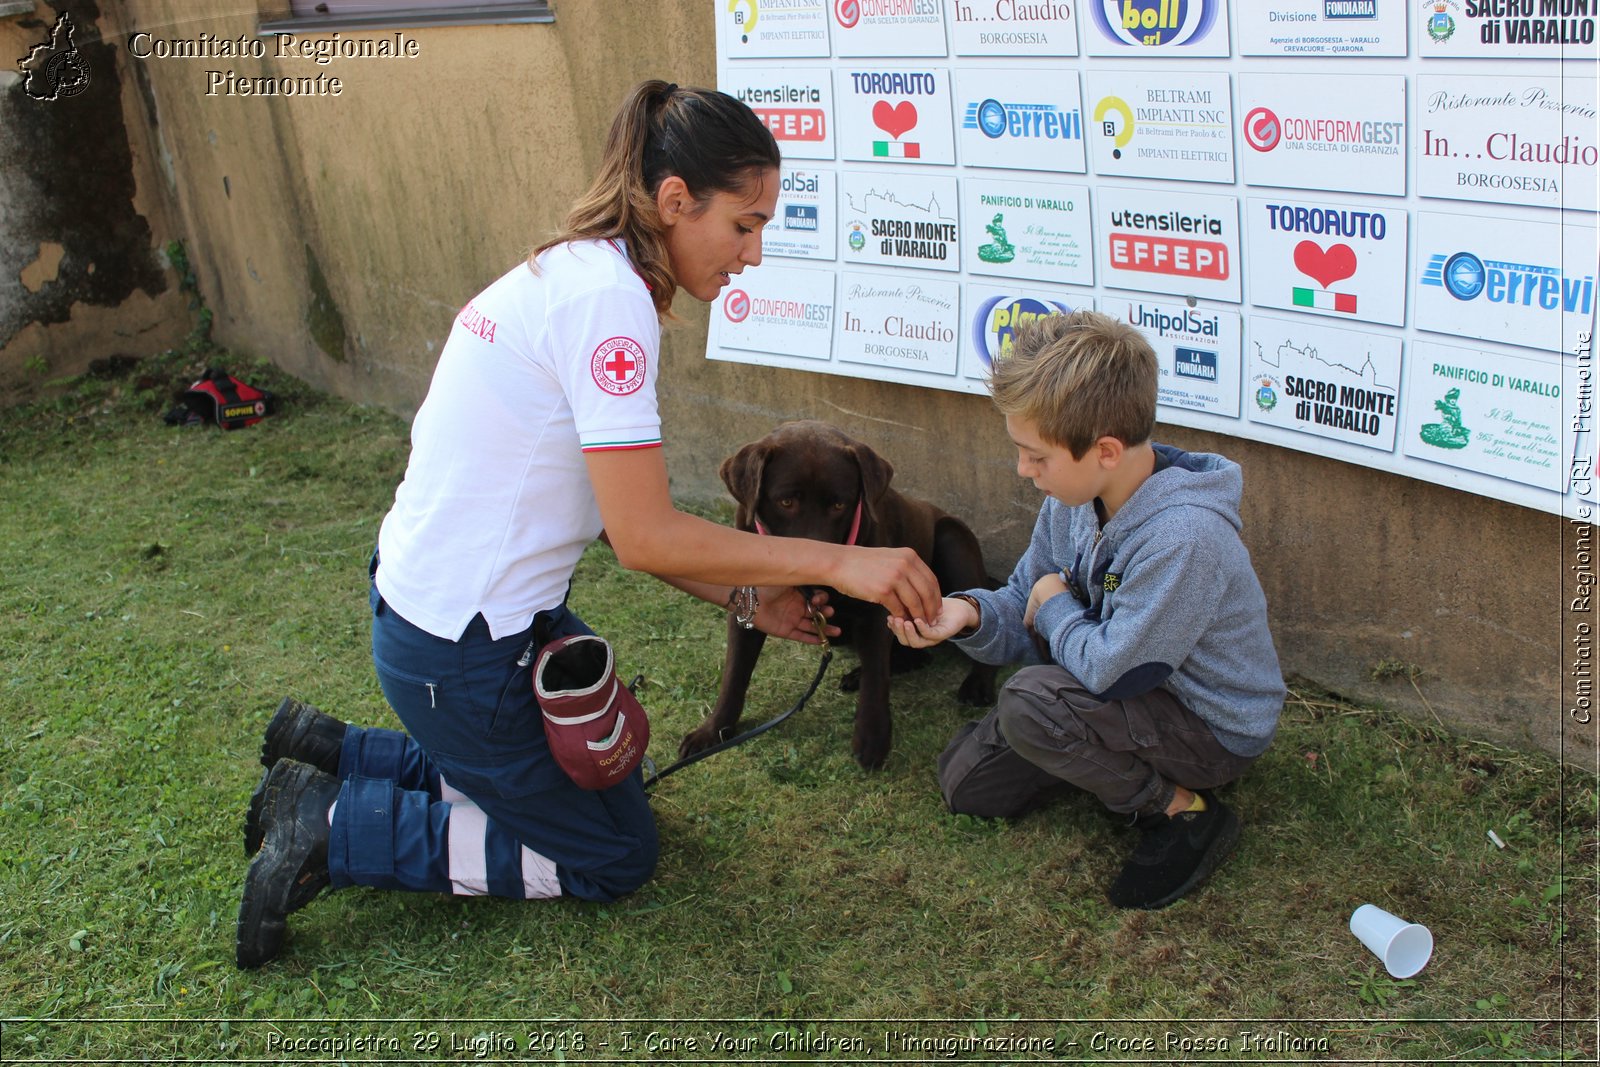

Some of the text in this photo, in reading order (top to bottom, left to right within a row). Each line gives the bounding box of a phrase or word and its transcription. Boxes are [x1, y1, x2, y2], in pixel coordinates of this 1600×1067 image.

[861, 0, 940, 17] CONFORMGEST
[1122, 0, 1181, 30] boll
[1269, 12, 1317, 22] Divisione
[1326, 1, 1375, 16] FONDIARIA
[1466, 0, 1534, 18] SACRO
[878, 17, 900, 25] SCELTA
[980, 33, 1048, 44] BORGOSESIA
[1142, 31, 1162, 46] srl
[1481, 19, 1595, 44] di VARALLO
[1270, 37, 1294, 45] Agenzie
[851, 72, 936, 96] TOROAUTO
[737, 86, 821, 103] utensileria
[1147, 90, 1212, 104] BELTRAMI
[1428, 86, 1597, 119] Ristorante Pizzeria
[1137, 107, 1225, 124] IMPIANTI SNC
[1145, 127, 1174, 137] Beltrami
[1176, 128, 1189, 137] Pier
[1191, 129, 1209, 138] Paolo
[1284, 118, 1403, 146] CONFORMGEST
[1138, 148, 1227, 163] IMPIANTI ELETTRICI
[1285, 142, 1398, 156] UNA SCELTA DI GARANZIA
[1456, 172, 1559, 193] BORGOSESIA
[981, 194, 1073, 212] PANIFICIO DI VARALLO
[872, 219, 912, 239] SACRO
[914, 222, 957, 243] MONTE
[1112, 210, 1222, 236] utensileria
[1266, 204, 1386, 241] TOROAUTO
[880, 238, 947, 261] di VARALLO
[1113, 239, 1226, 275] EFFEPI
[848, 284, 904, 301] Ristorante
[752, 298, 833, 322] CONFORMGEST
[1128, 303, 1219, 337] UnipolSai
[864, 343, 929, 361] BORGOSESIA
[1191, 352, 1201, 364] LA
[1176, 361, 1216, 379] FONDIARIA
[1433, 362, 1561, 399] PANIFICIO DI VARALLO
[1285, 375, 1338, 405] SACRO
[1340, 385, 1396, 417] MONTE
[1295, 400, 1381, 436] di VARALLO
[600, 746, 623, 767] GOODY
